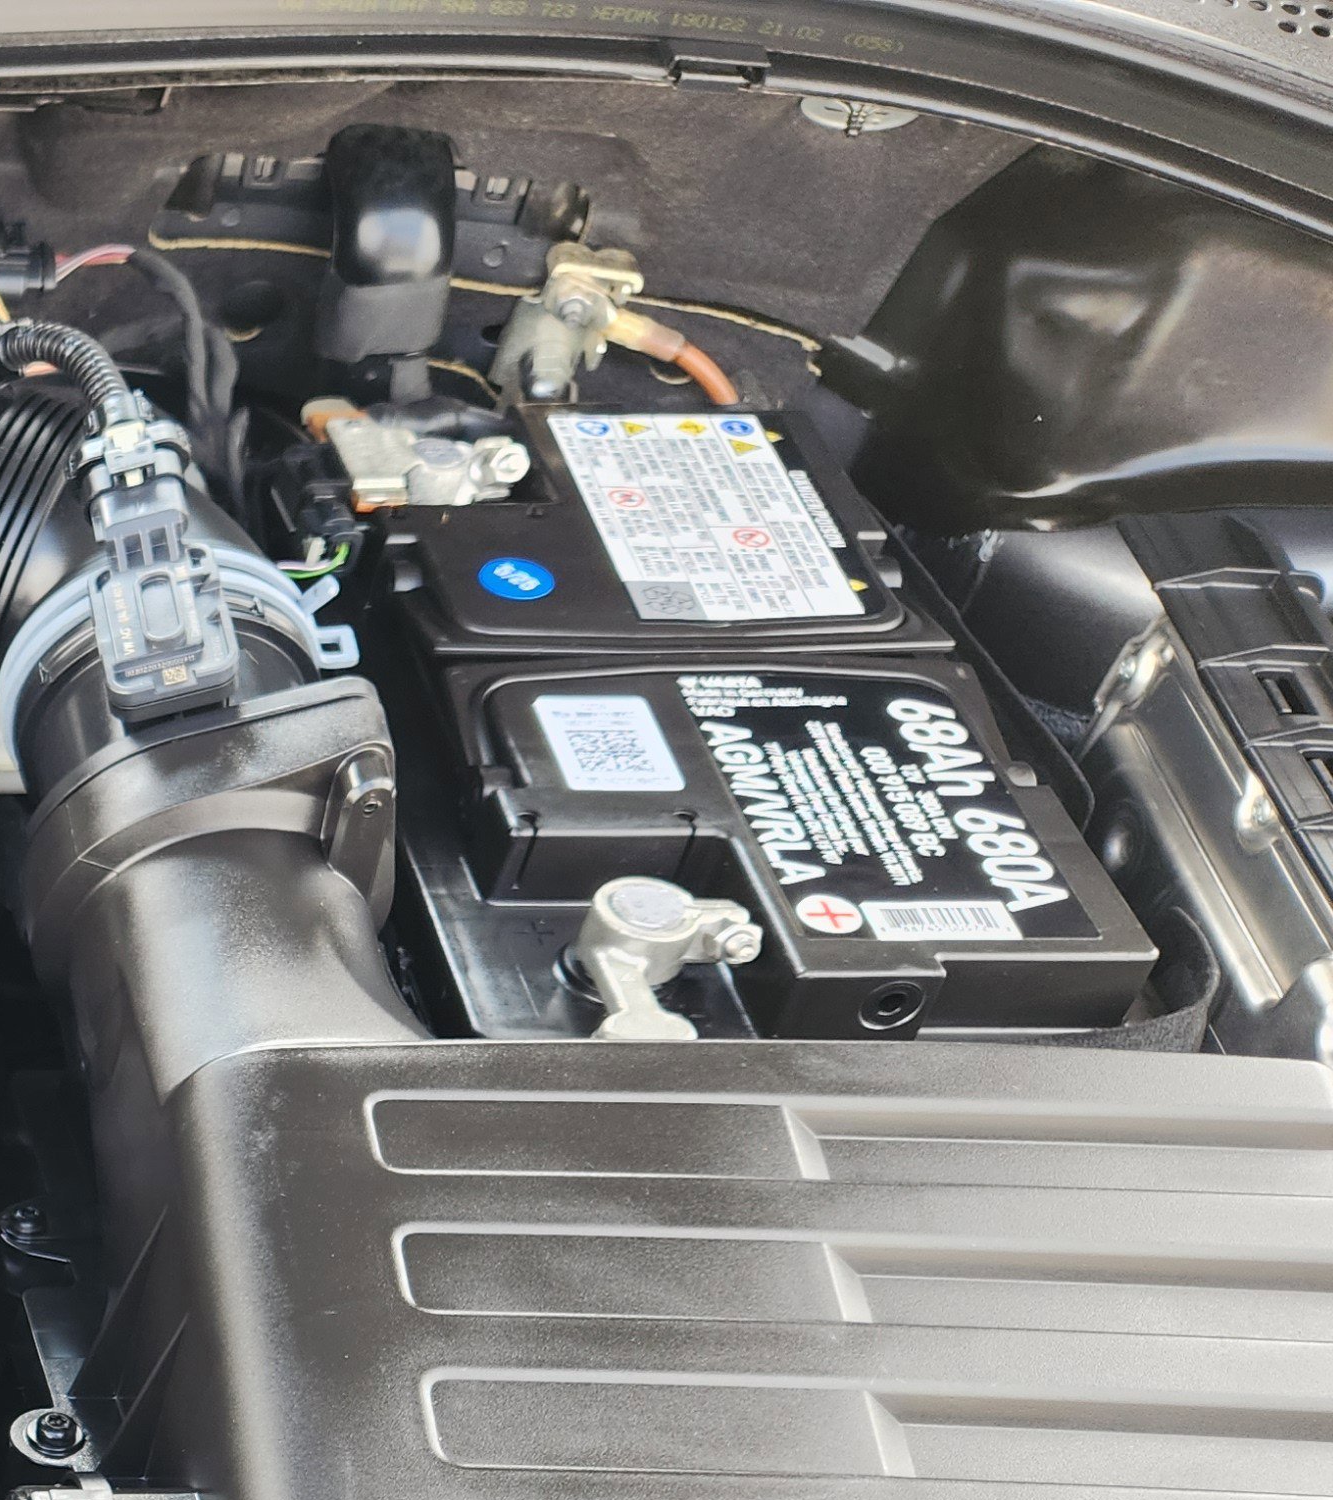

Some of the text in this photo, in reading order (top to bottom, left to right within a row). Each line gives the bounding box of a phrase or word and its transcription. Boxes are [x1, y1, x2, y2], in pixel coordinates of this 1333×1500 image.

[860, 746, 895, 775] 000
[700, 720, 826, 884] AGM/VRLA
[876, 774, 915, 804] 915
[887, 697, 995, 797] 68Ah
[954, 808, 1069, 913] 680A
[908, 832, 946, 858] BC
